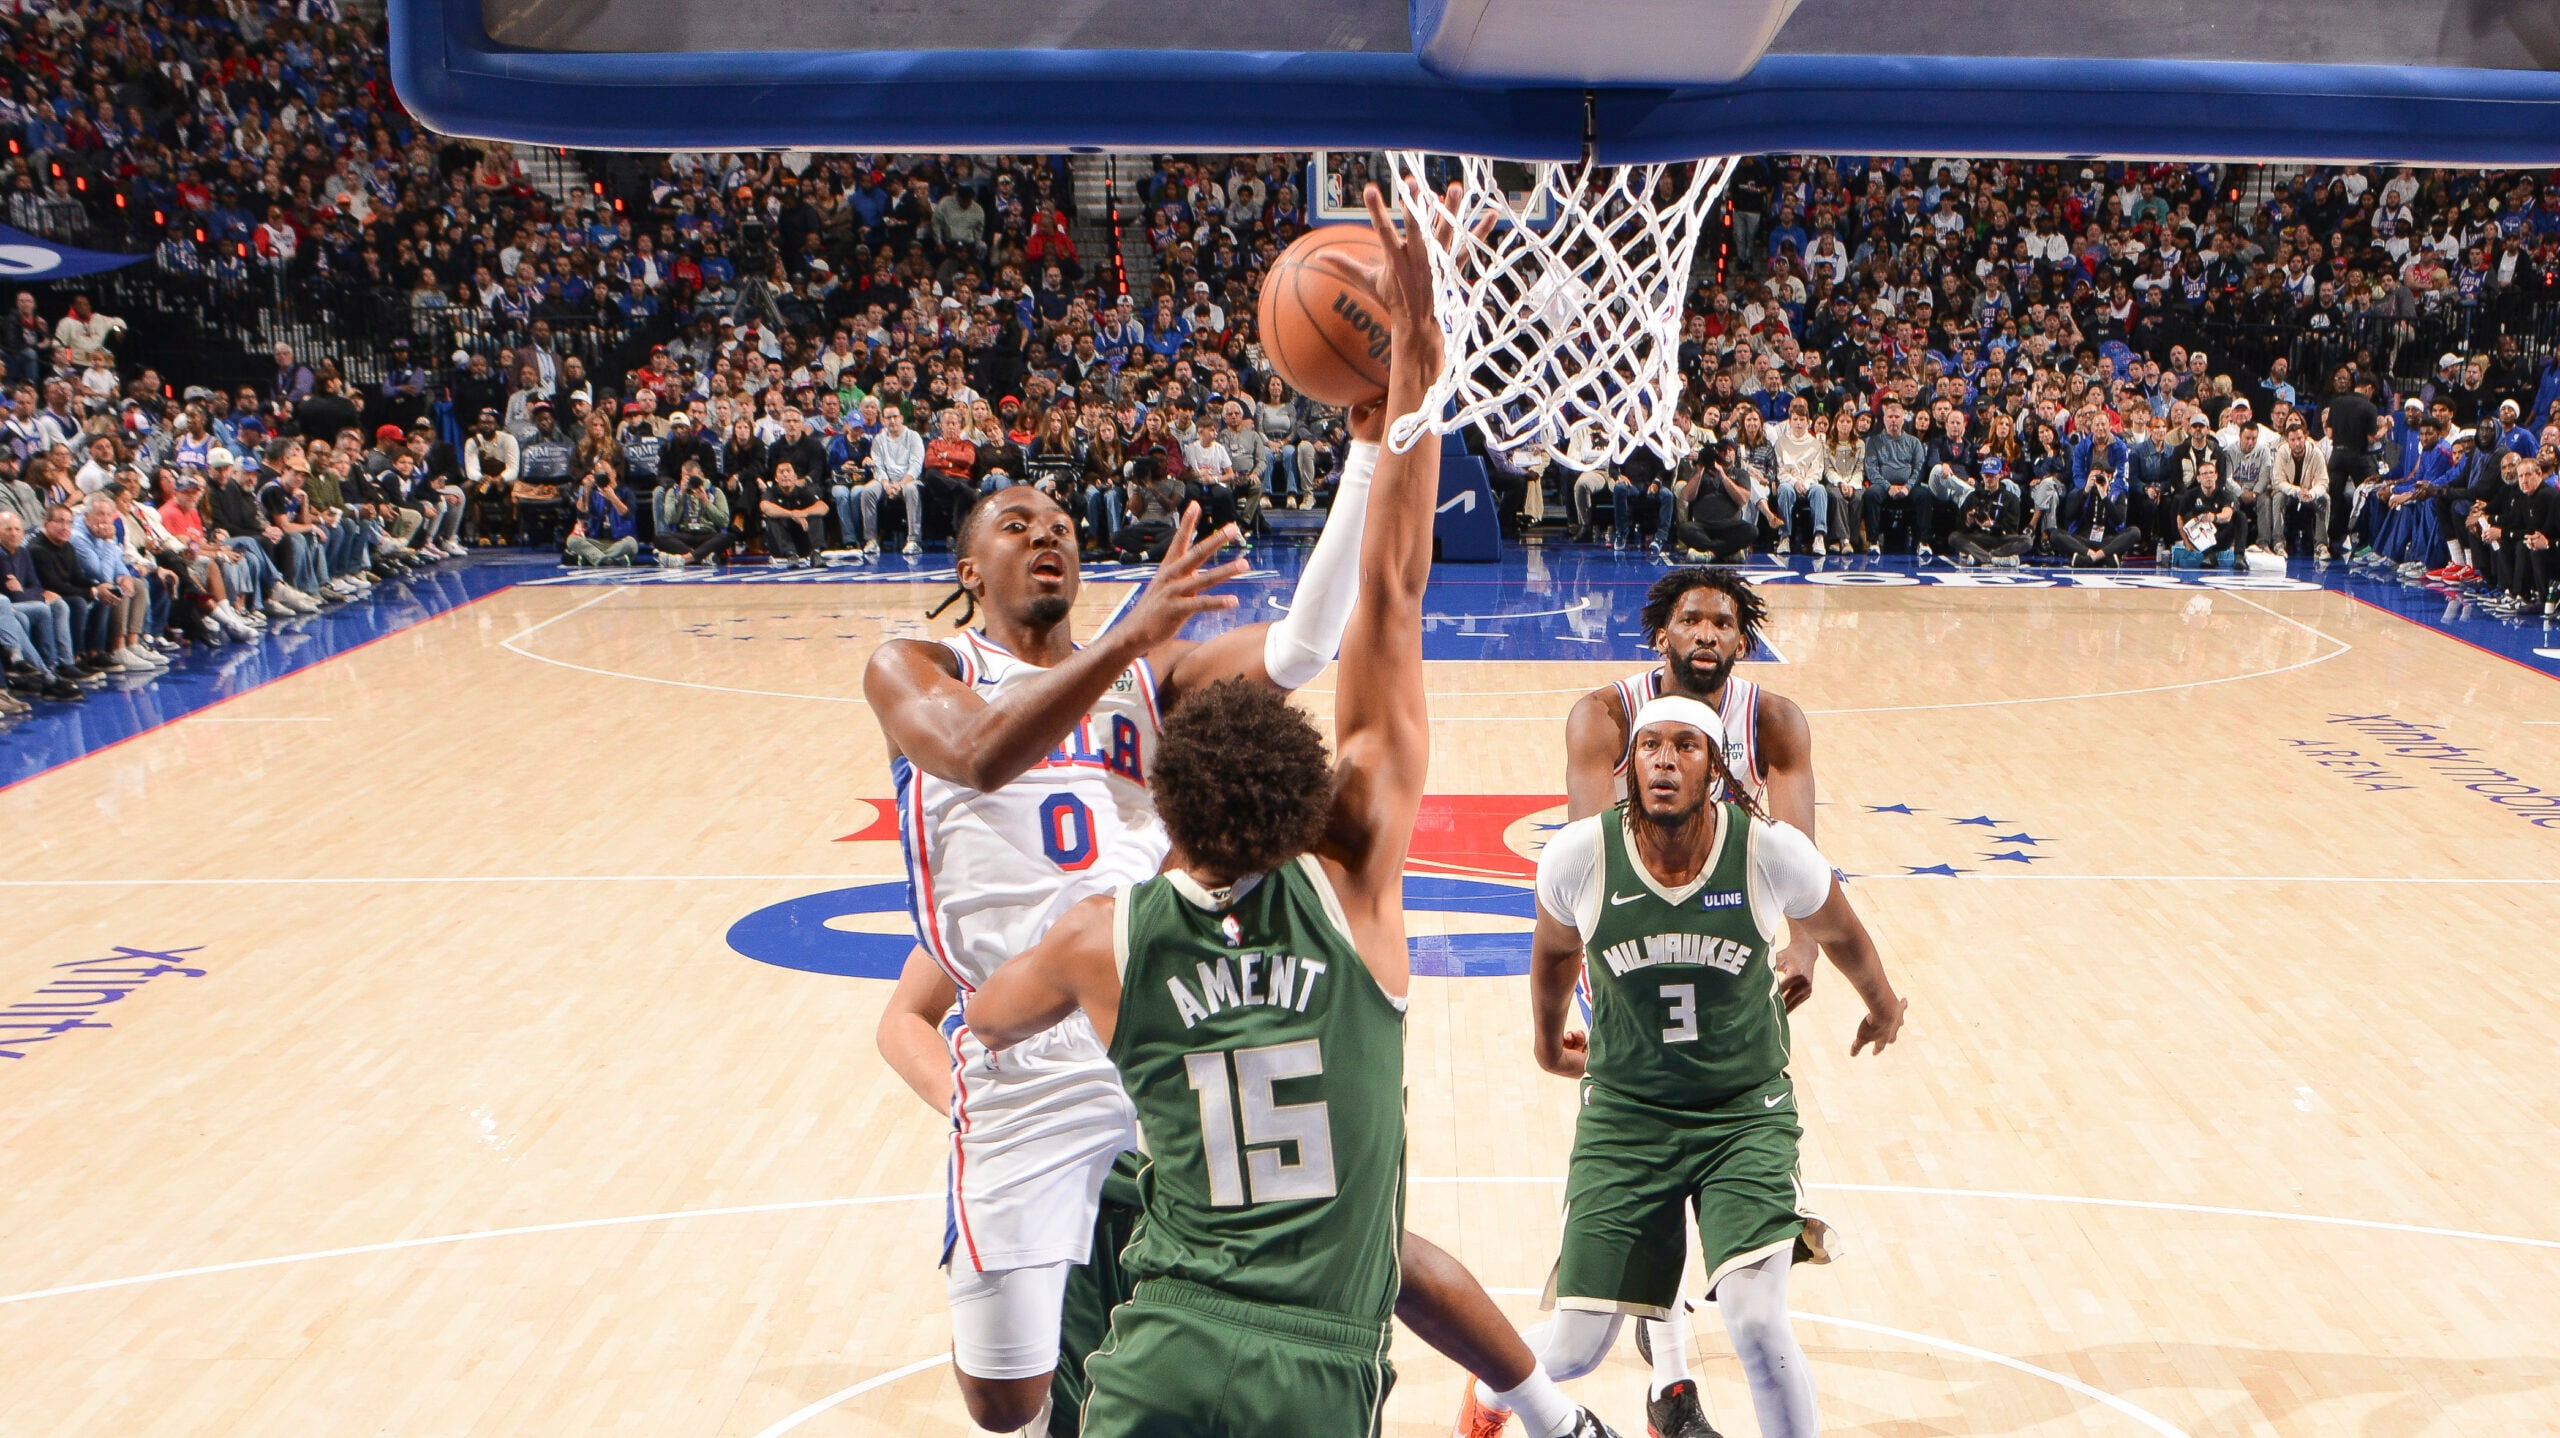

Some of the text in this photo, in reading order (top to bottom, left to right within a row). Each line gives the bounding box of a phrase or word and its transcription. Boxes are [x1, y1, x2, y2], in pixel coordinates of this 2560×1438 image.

[1333, 291, 1391, 372] lson
[1736, 570, 2322, 591] 76ERS
[2279, 738, 2420, 792] ARENA
[1039, 792, 1098, 872] 0
[1704, 892, 1742, 907] ULINE
[1602, 933, 1752, 977] MILWAUKEE
[1166, 953, 1327, 1030] AMENT
[1659, 983, 1699, 1043] 3
[1183, 1038, 1337, 1206] 15
